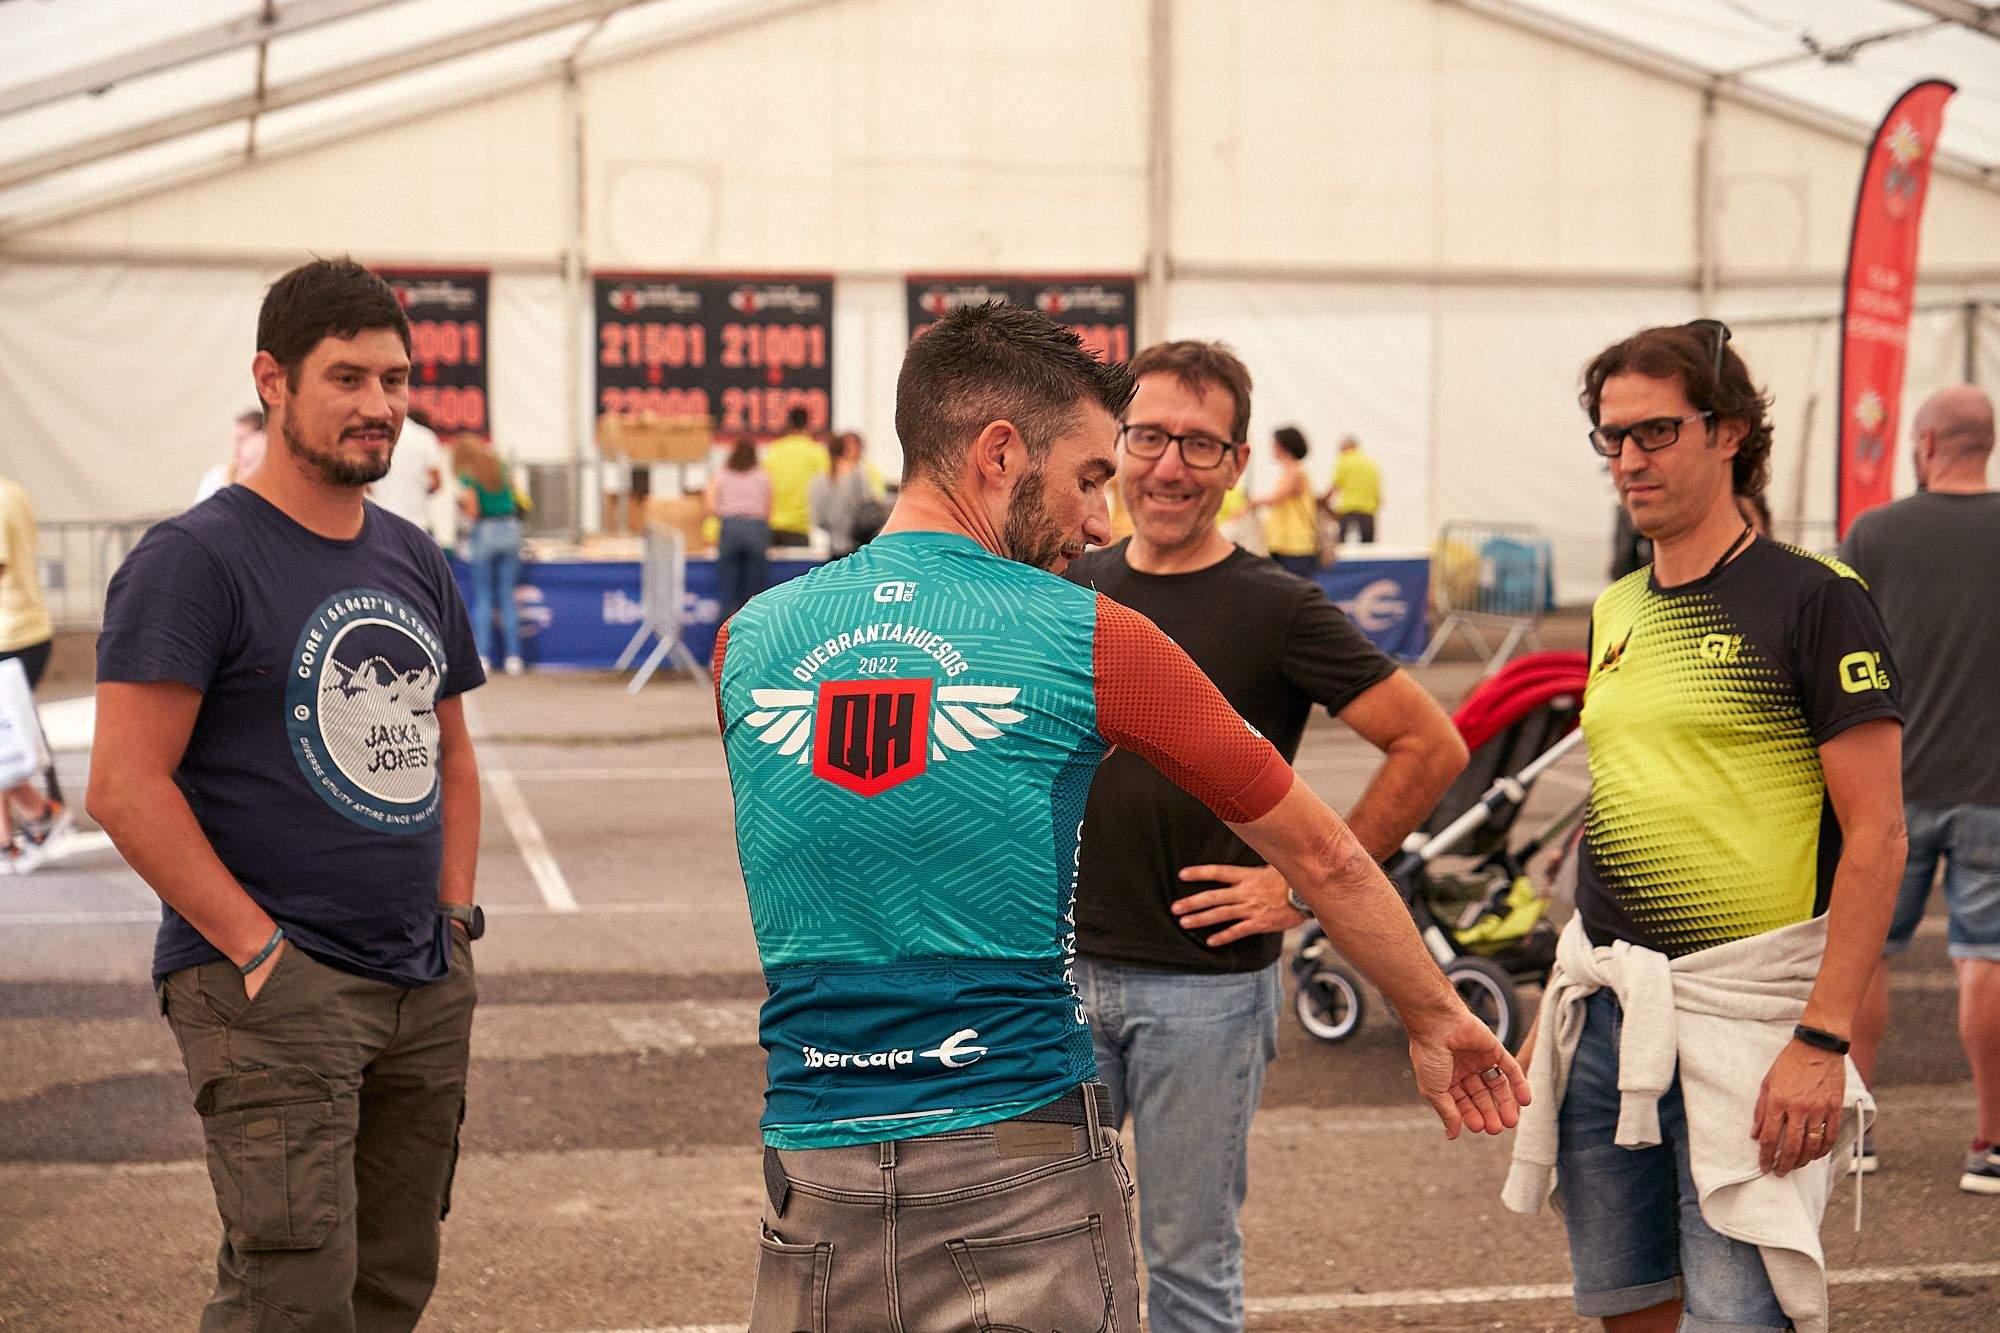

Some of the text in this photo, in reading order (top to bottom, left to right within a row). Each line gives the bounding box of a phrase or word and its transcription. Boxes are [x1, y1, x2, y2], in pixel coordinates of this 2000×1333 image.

[600, 321, 706, 368] 21501
[720, 321, 826, 368] 21001
[298, 628, 324, 679] CORE
[792, 622, 969, 683] QUEBRANTAHUESOS
[858, 656, 899, 675] 2022
[367, 746, 428, 774] JONES
[827, 693, 915, 780] QH
[300, 737, 325, 777] DIVERSE
[321, 777, 354, 806] UTILITY
[352, 803, 385, 822] ATTIRE
[385, 813, 411, 825] SINCE
[802, 1046, 914, 1070] ibercaja
